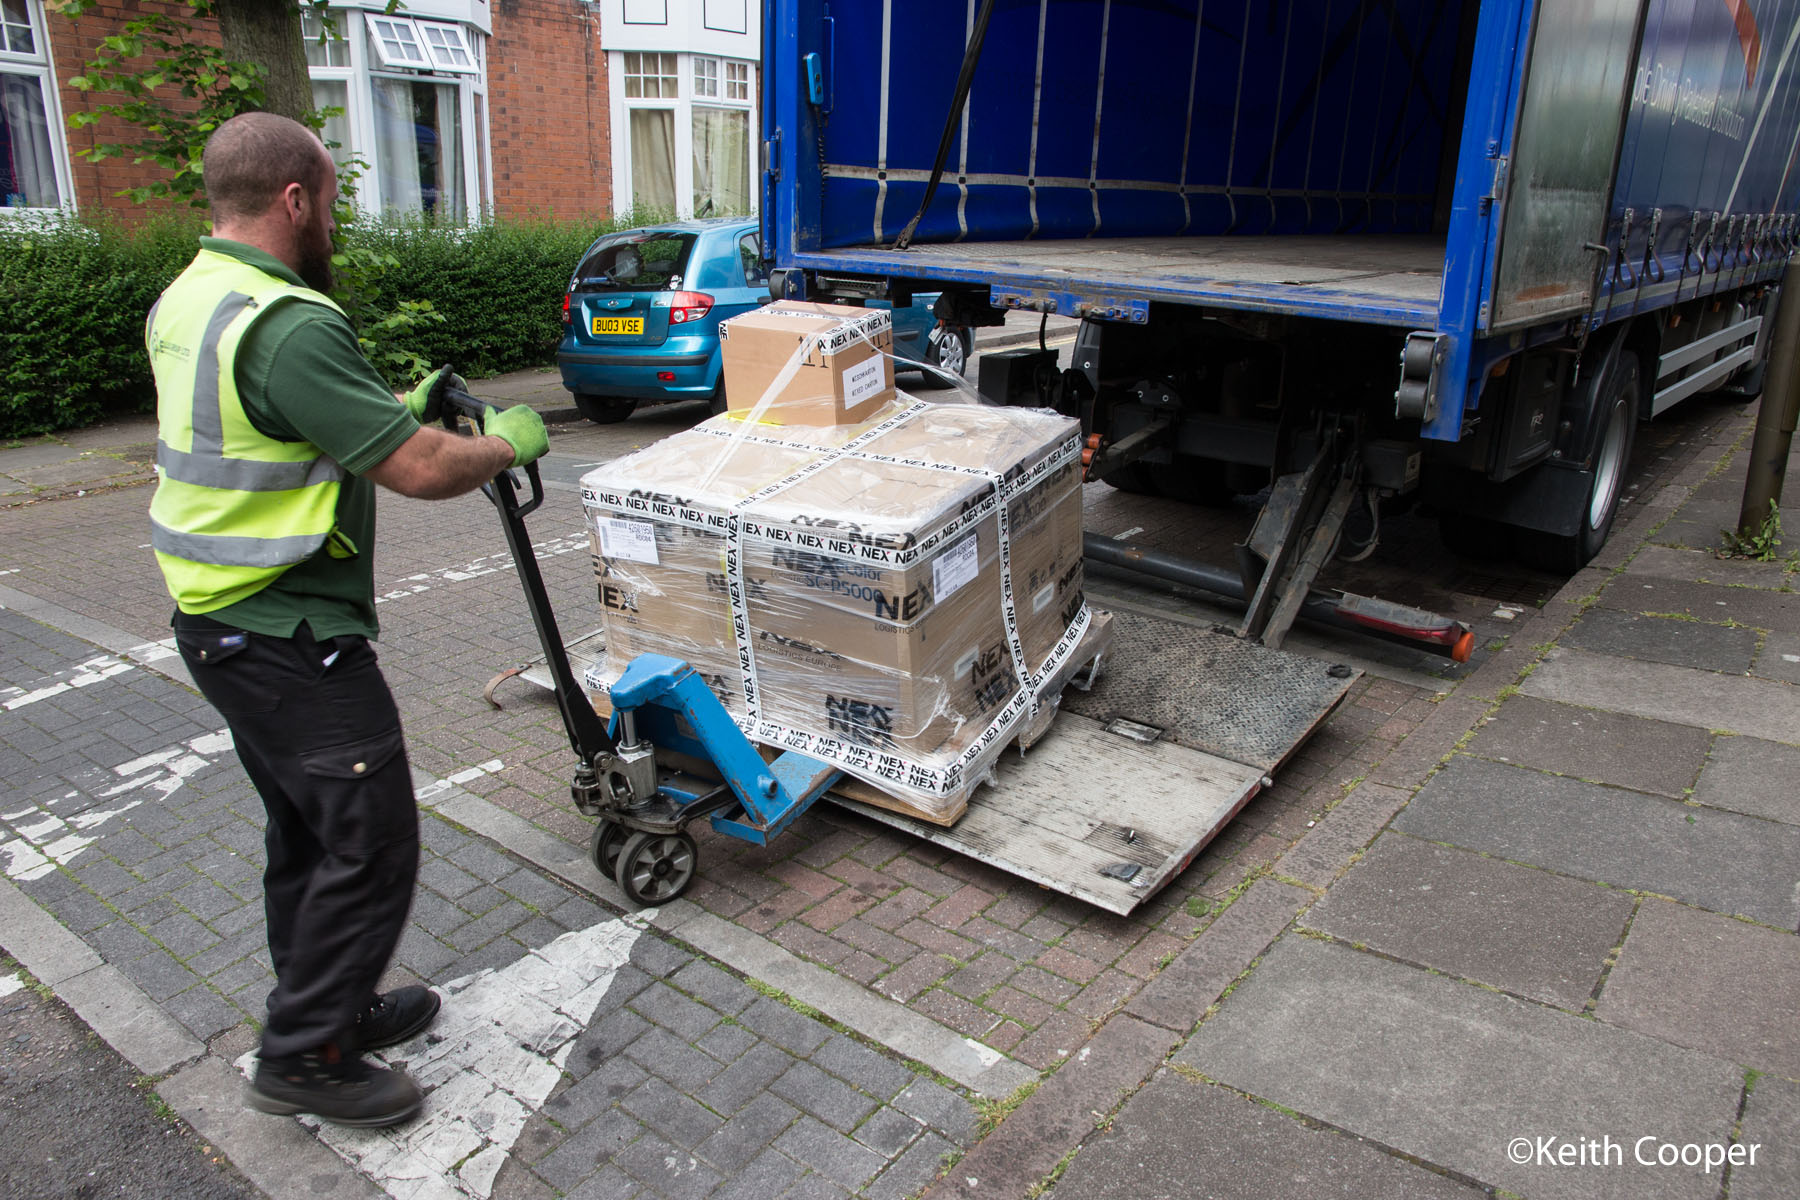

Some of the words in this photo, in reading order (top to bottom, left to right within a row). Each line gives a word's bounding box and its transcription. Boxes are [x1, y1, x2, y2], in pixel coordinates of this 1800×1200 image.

[595, 319, 619, 332] BU03
[621, 319, 640, 332] VSE
[830, 332, 848, 349] NEX
[867, 316, 882, 332] NEX
[759, 483, 783, 497] NEX
[782, 472, 805, 485] NEX
[803, 462, 824, 475] NEX
[823, 450, 843, 463] NEX
[842, 439, 862, 452] NEX
[860, 430, 878, 442] NEX
[877, 420, 896, 432] NEX
[896, 410, 911, 422] NEX
[911, 400, 928, 412] NEX
[901, 458, 926, 467] NEX
[931, 463, 957, 471] NEX
[962, 467, 990, 477] NEX
[600, 493, 623, 506] NEX
[626, 497, 649, 512] NEX
[652, 502, 676, 518] NEX
[680, 508, 704, 524] NEX
[766, 527, 792, 543] NEX
[797, 533, 824, 549] NEX
[829, 540, 857, 556] NEX
[861, 546, 890, 562] NEX
[895, 549, 918, 565] NEX
[921, 533, 940, 554] NEX
[942, 518, 960, 540] NEX
[961, 505, 979, 528] NEX
[980, 493, 997, 515] NEX
[1048, 448, 1062, 467] NEX
[1063, 438, 1078, 455] NEX
[728, 511, 739, 543] NEX
[1000, 507, 1010, 537] NEX
[727, 544, 738, 577] NEX
[1002, 541, 1010, 569] NEX
[729, 577, 742, 609] NEX
[1003, 574, 1013, 602] NEX
[733, 610, 747, 641] NEX
[1006, 606, 1017, 635] NEX
[738, 643, 752, 673] NEX
[972, 640, 1010, 685] NEX
[1012, 639, 1025, 667] NEX
[742, 674, 756, 705] NEX
[848, 746, 876, 761] NEX
[879, 754, 908, 770] NEX
[910, 764, 940, 780] NEX
[963, 742, 982, 764] NEX
[981, 724, 999, 746] NEX
[997, 705, 1015, 729] NEX
[1042, 654, 1057, 676] NEX
[1054, 638, 1070, 660] NEX
[1065, 623, 1079, 644] NEX
[1075, 606, 1087, 629] NEX
[744, 706, 757, 736] NEX
[813, 745, 842, 760] NEX
[843, 755, 873, 770] NEX
[875, 764, 905, 781] NEX
[908, 773, 938, 790] NEX
[942, 774, 961, 793] NEX
